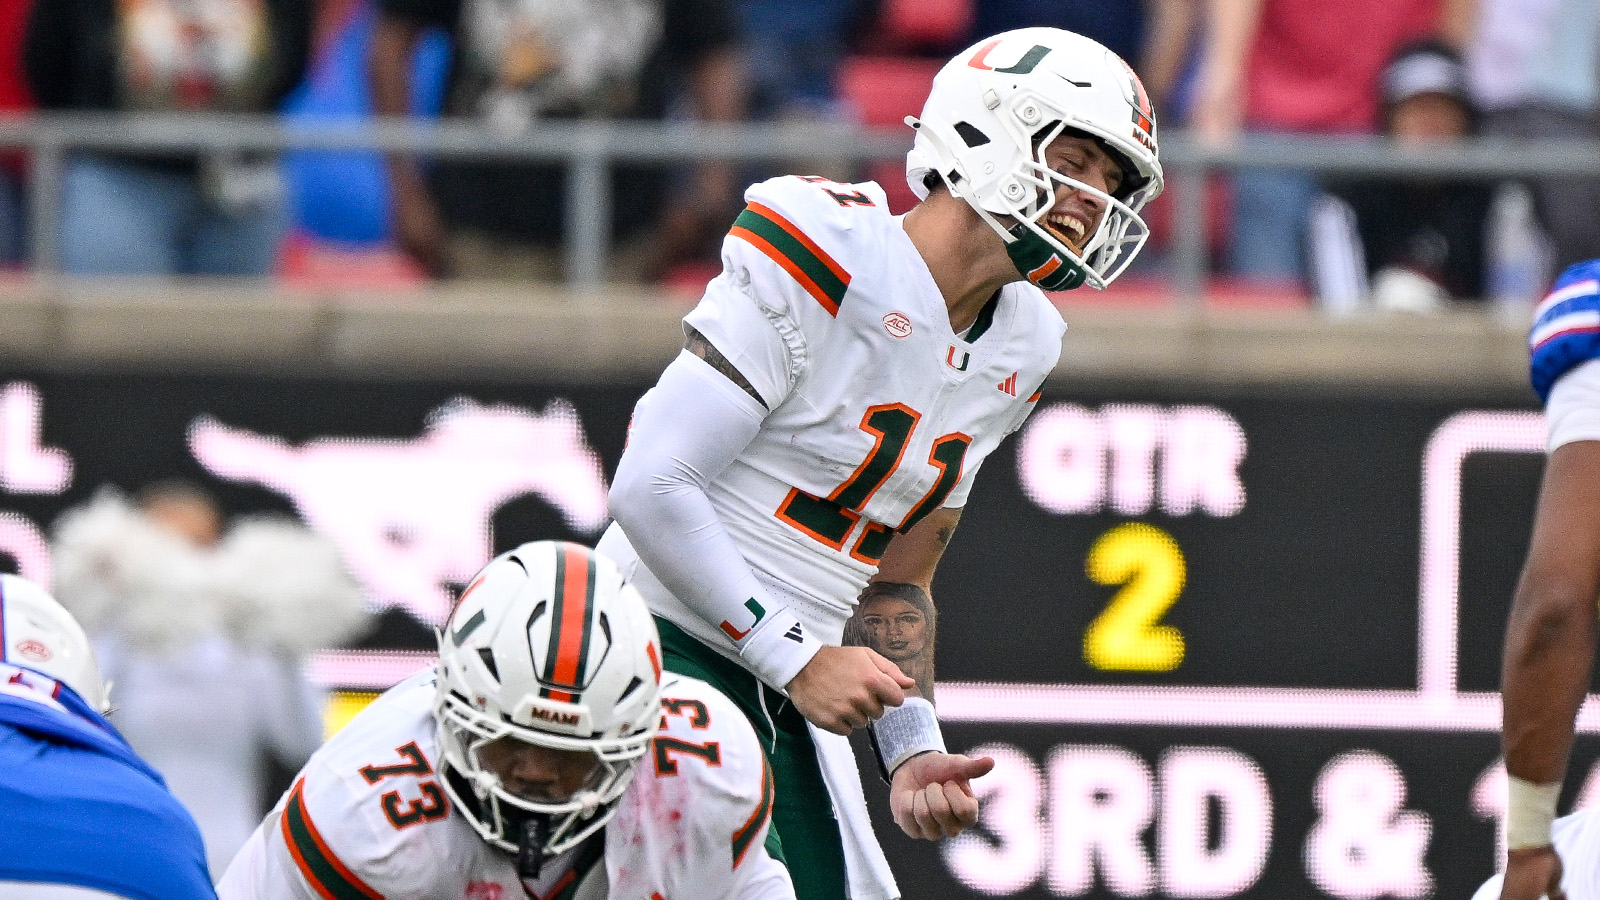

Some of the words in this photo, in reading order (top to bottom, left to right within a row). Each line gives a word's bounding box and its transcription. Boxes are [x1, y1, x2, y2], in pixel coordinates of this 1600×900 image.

[886, 317, 911, 333] ACC
[945, 344, 971, 372] U
[774, 402, 973, 566] 11
[1083, 521, 1188, 674] 2
[531, 705, 581, 728] MIAMI
[651, 697, 722, 778] 73
[358, 741, 450, 831] 73
[941, 742, 1274, 899] 3RD
[1304, 748, 1437, 900] &
